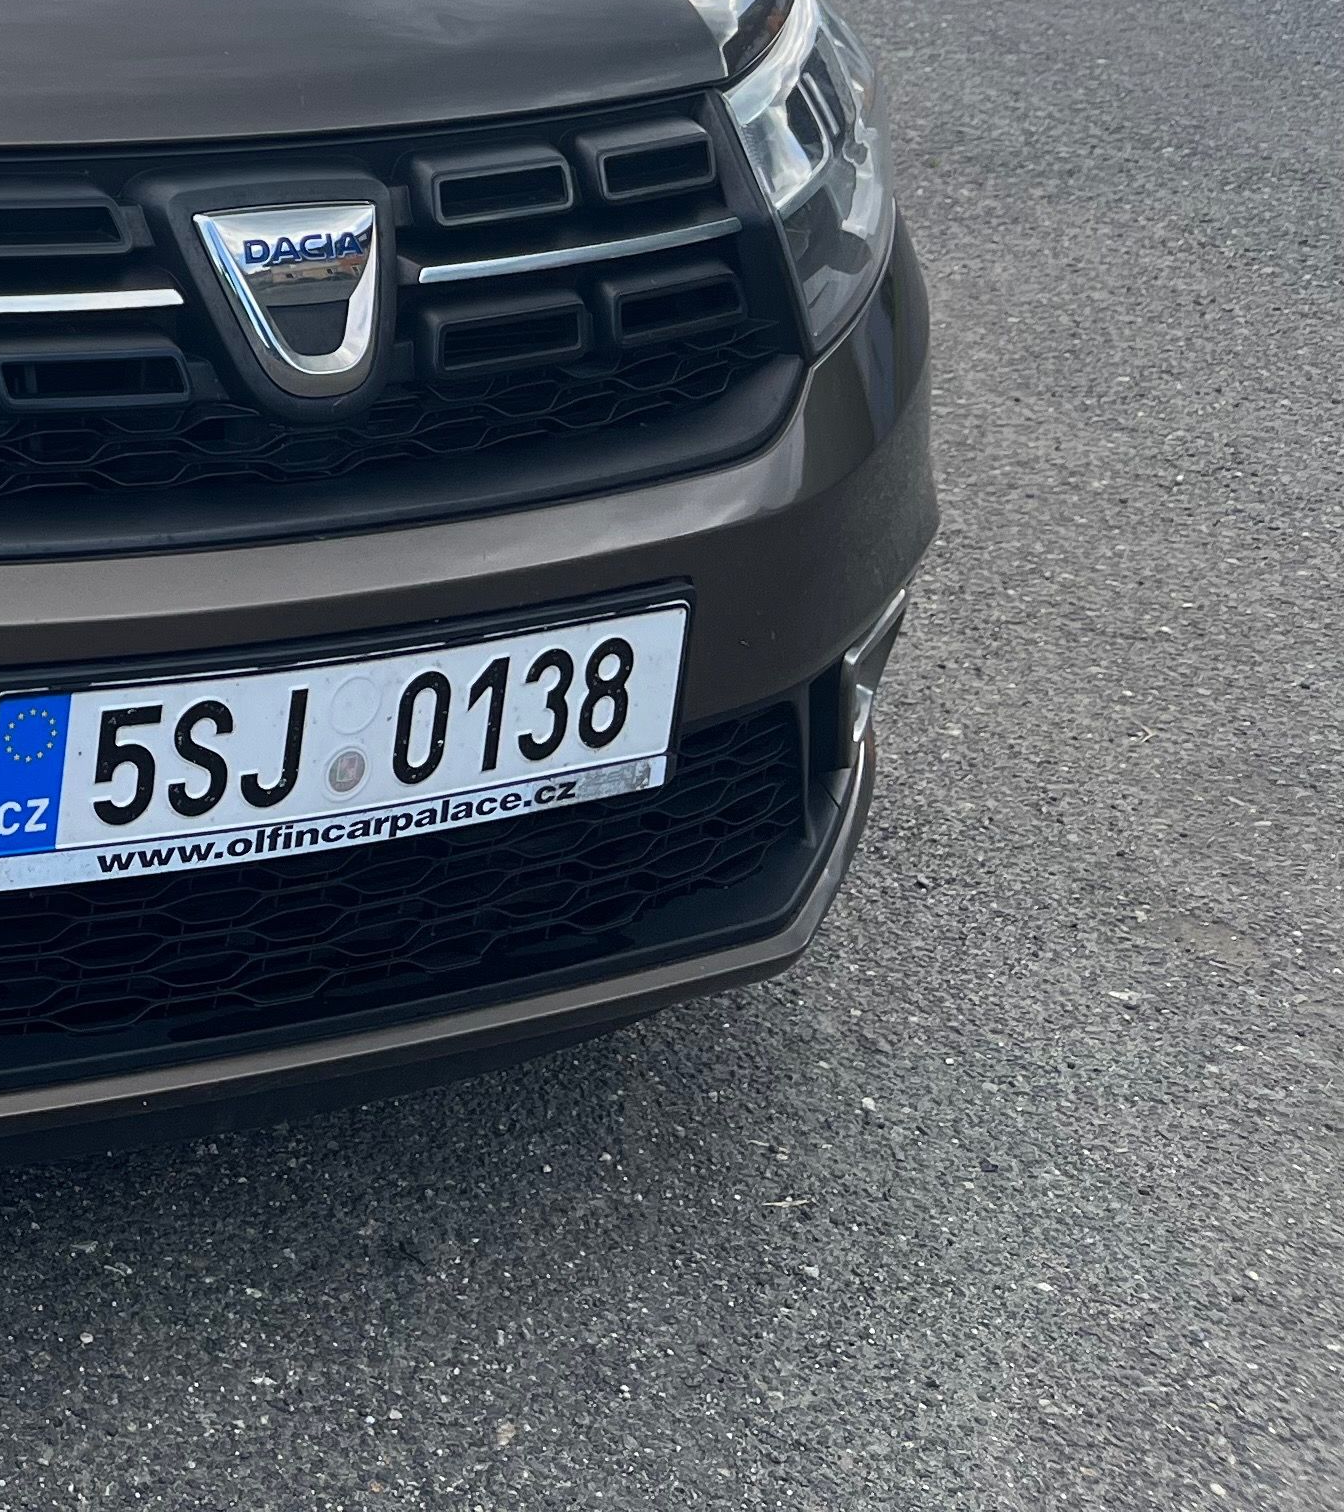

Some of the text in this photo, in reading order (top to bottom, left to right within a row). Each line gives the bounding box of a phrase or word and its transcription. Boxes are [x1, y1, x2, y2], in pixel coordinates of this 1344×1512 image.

[243, 231, 363, 265] DACIA
[92, 637, 634, 826] 5SJ 0138
[97, 780, 577, 874] www.olfincarpalace.cz
